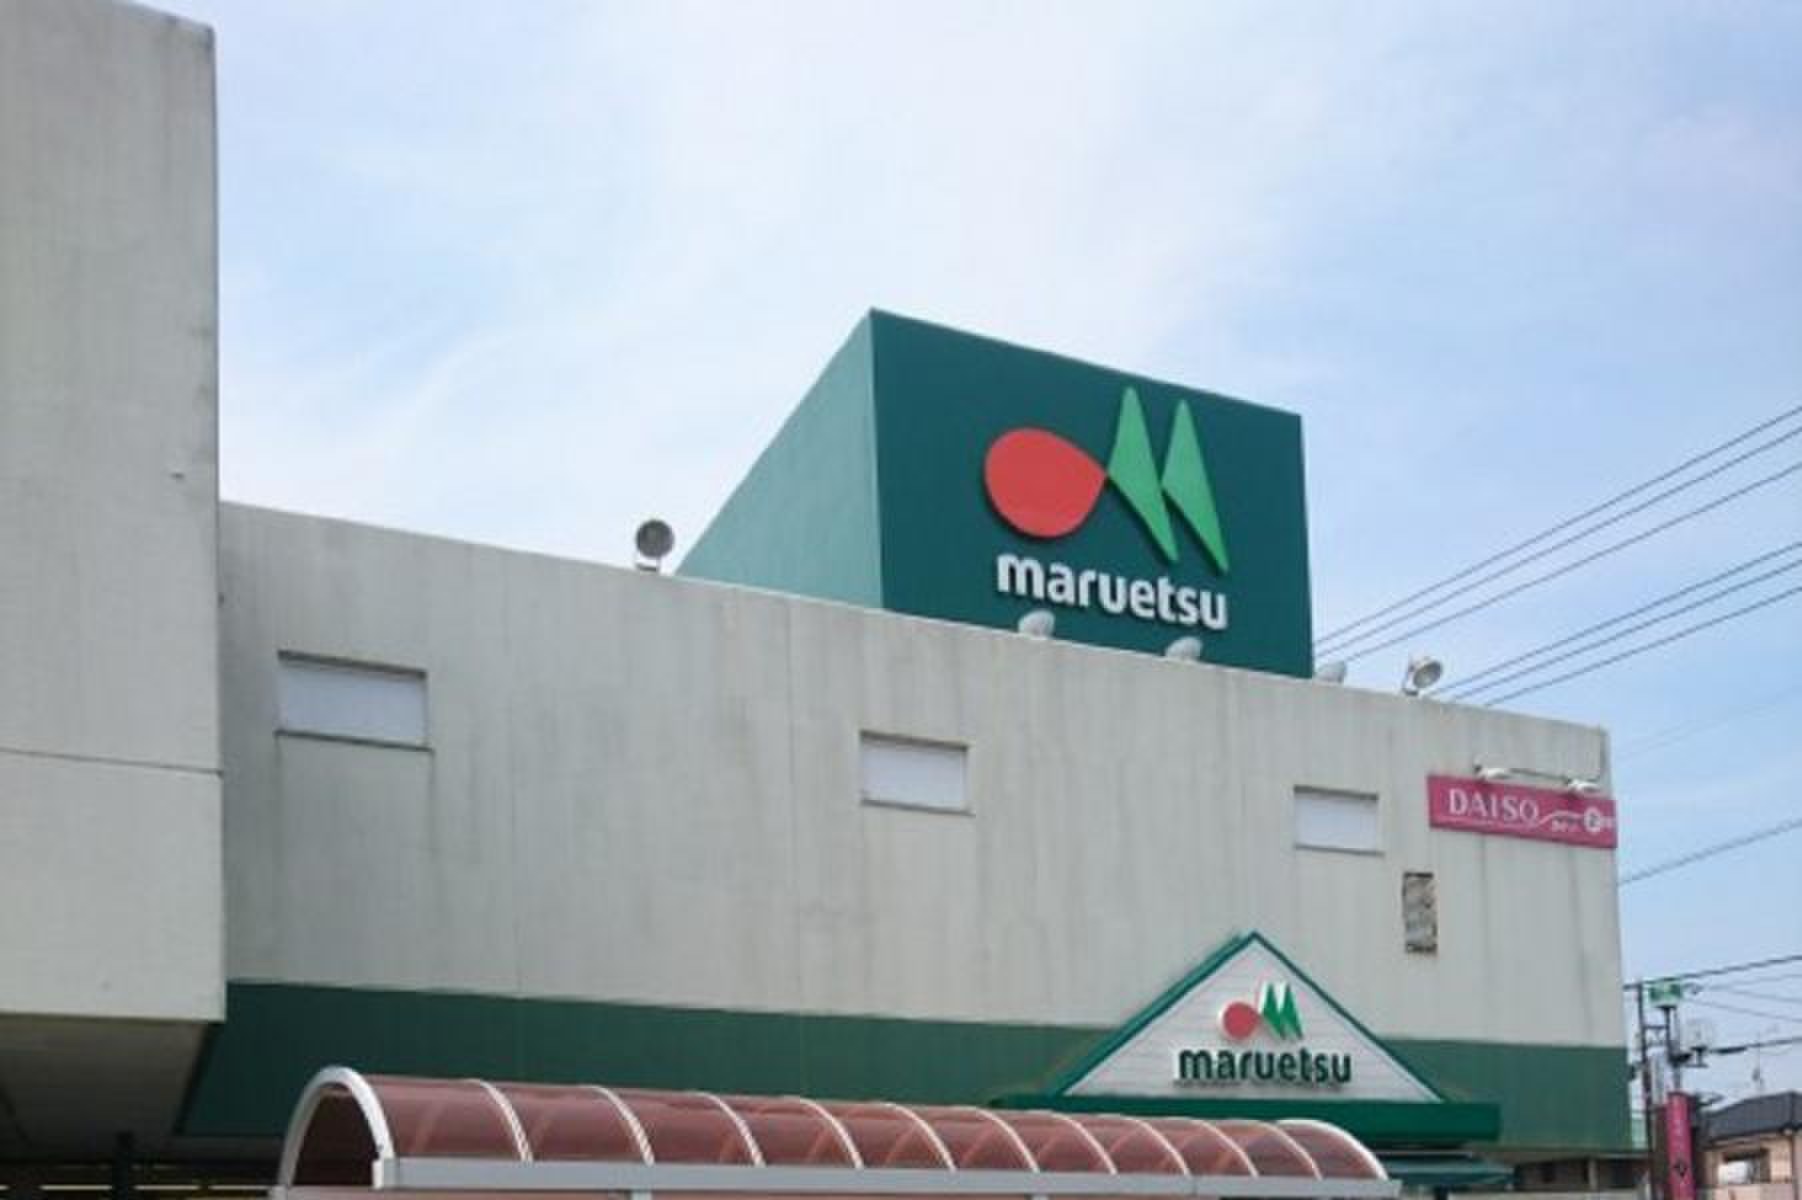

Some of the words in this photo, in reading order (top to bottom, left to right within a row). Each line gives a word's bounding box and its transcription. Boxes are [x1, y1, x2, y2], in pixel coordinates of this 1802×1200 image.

[996, 553, 1228, 630] maruetsu
[1449, 787, 1540, 823] DAISO
[1177, 1047, 1353, 1084] maruetsu
